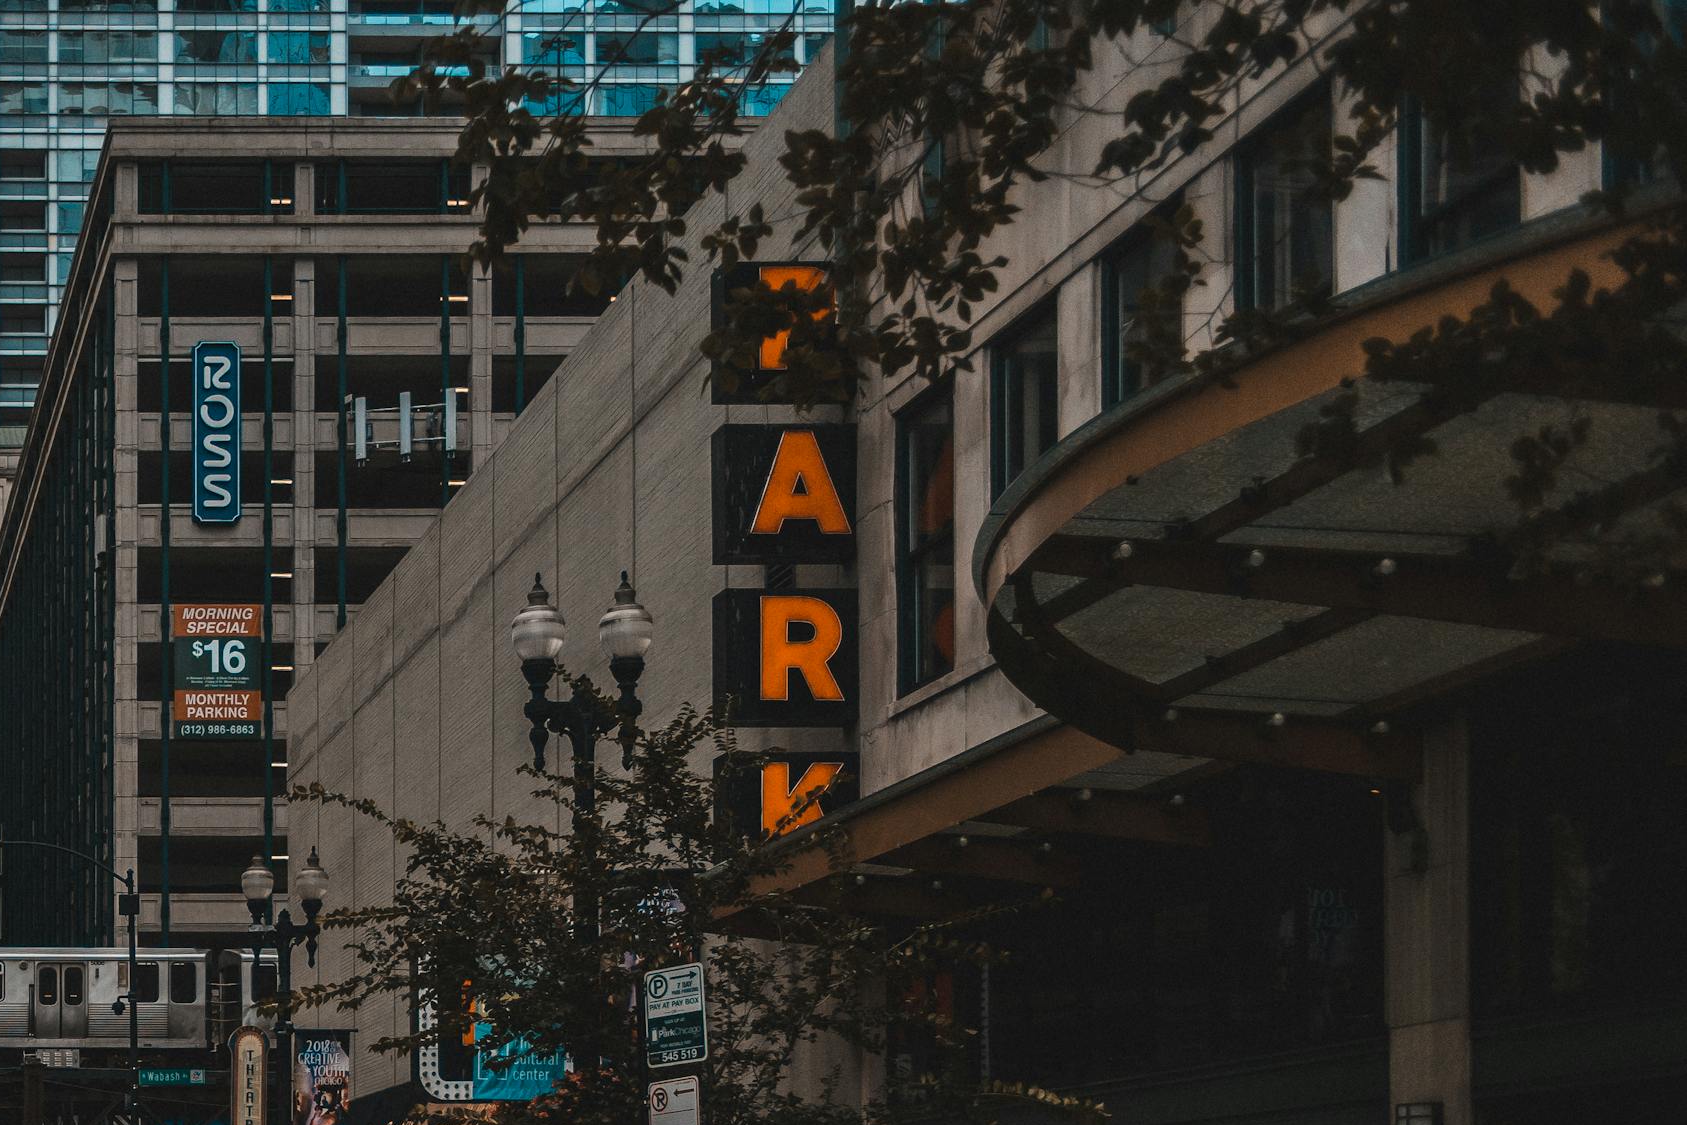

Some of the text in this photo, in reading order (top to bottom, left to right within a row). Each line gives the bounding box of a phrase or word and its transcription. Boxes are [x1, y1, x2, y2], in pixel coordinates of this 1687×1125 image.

[200, 355, 235, 508] ROSS
[182, 608, 253, 620] MORNING
[186, 622, 249, 634] SPECIAL
[192, 640, 246, 673] $16
[185, 694, 250, 705] MONTHLY
[187, 707, 248, 719] PARKING
[181, 725, 254, 736] (312) 986-6863
[662, 1001, 670, 1009] AT
[672, 999, 684, 1008] PAY
[685, 997, 699, 1006] BOX
[658, 1026, 701, 1039] ParkChicago
[306, 1040, 331, 1052] 2018
[297, 1053, 341, 1065] CREATIVE
[662, 1048, 698, 1062] 545 519
[147, 1071, 181, 1081] Wabash
[313, 1065, 346, 1077] YOUTH
[513, 1069, 550, 1081] center
[314, 1077, 344, 1086] CHICAGO
